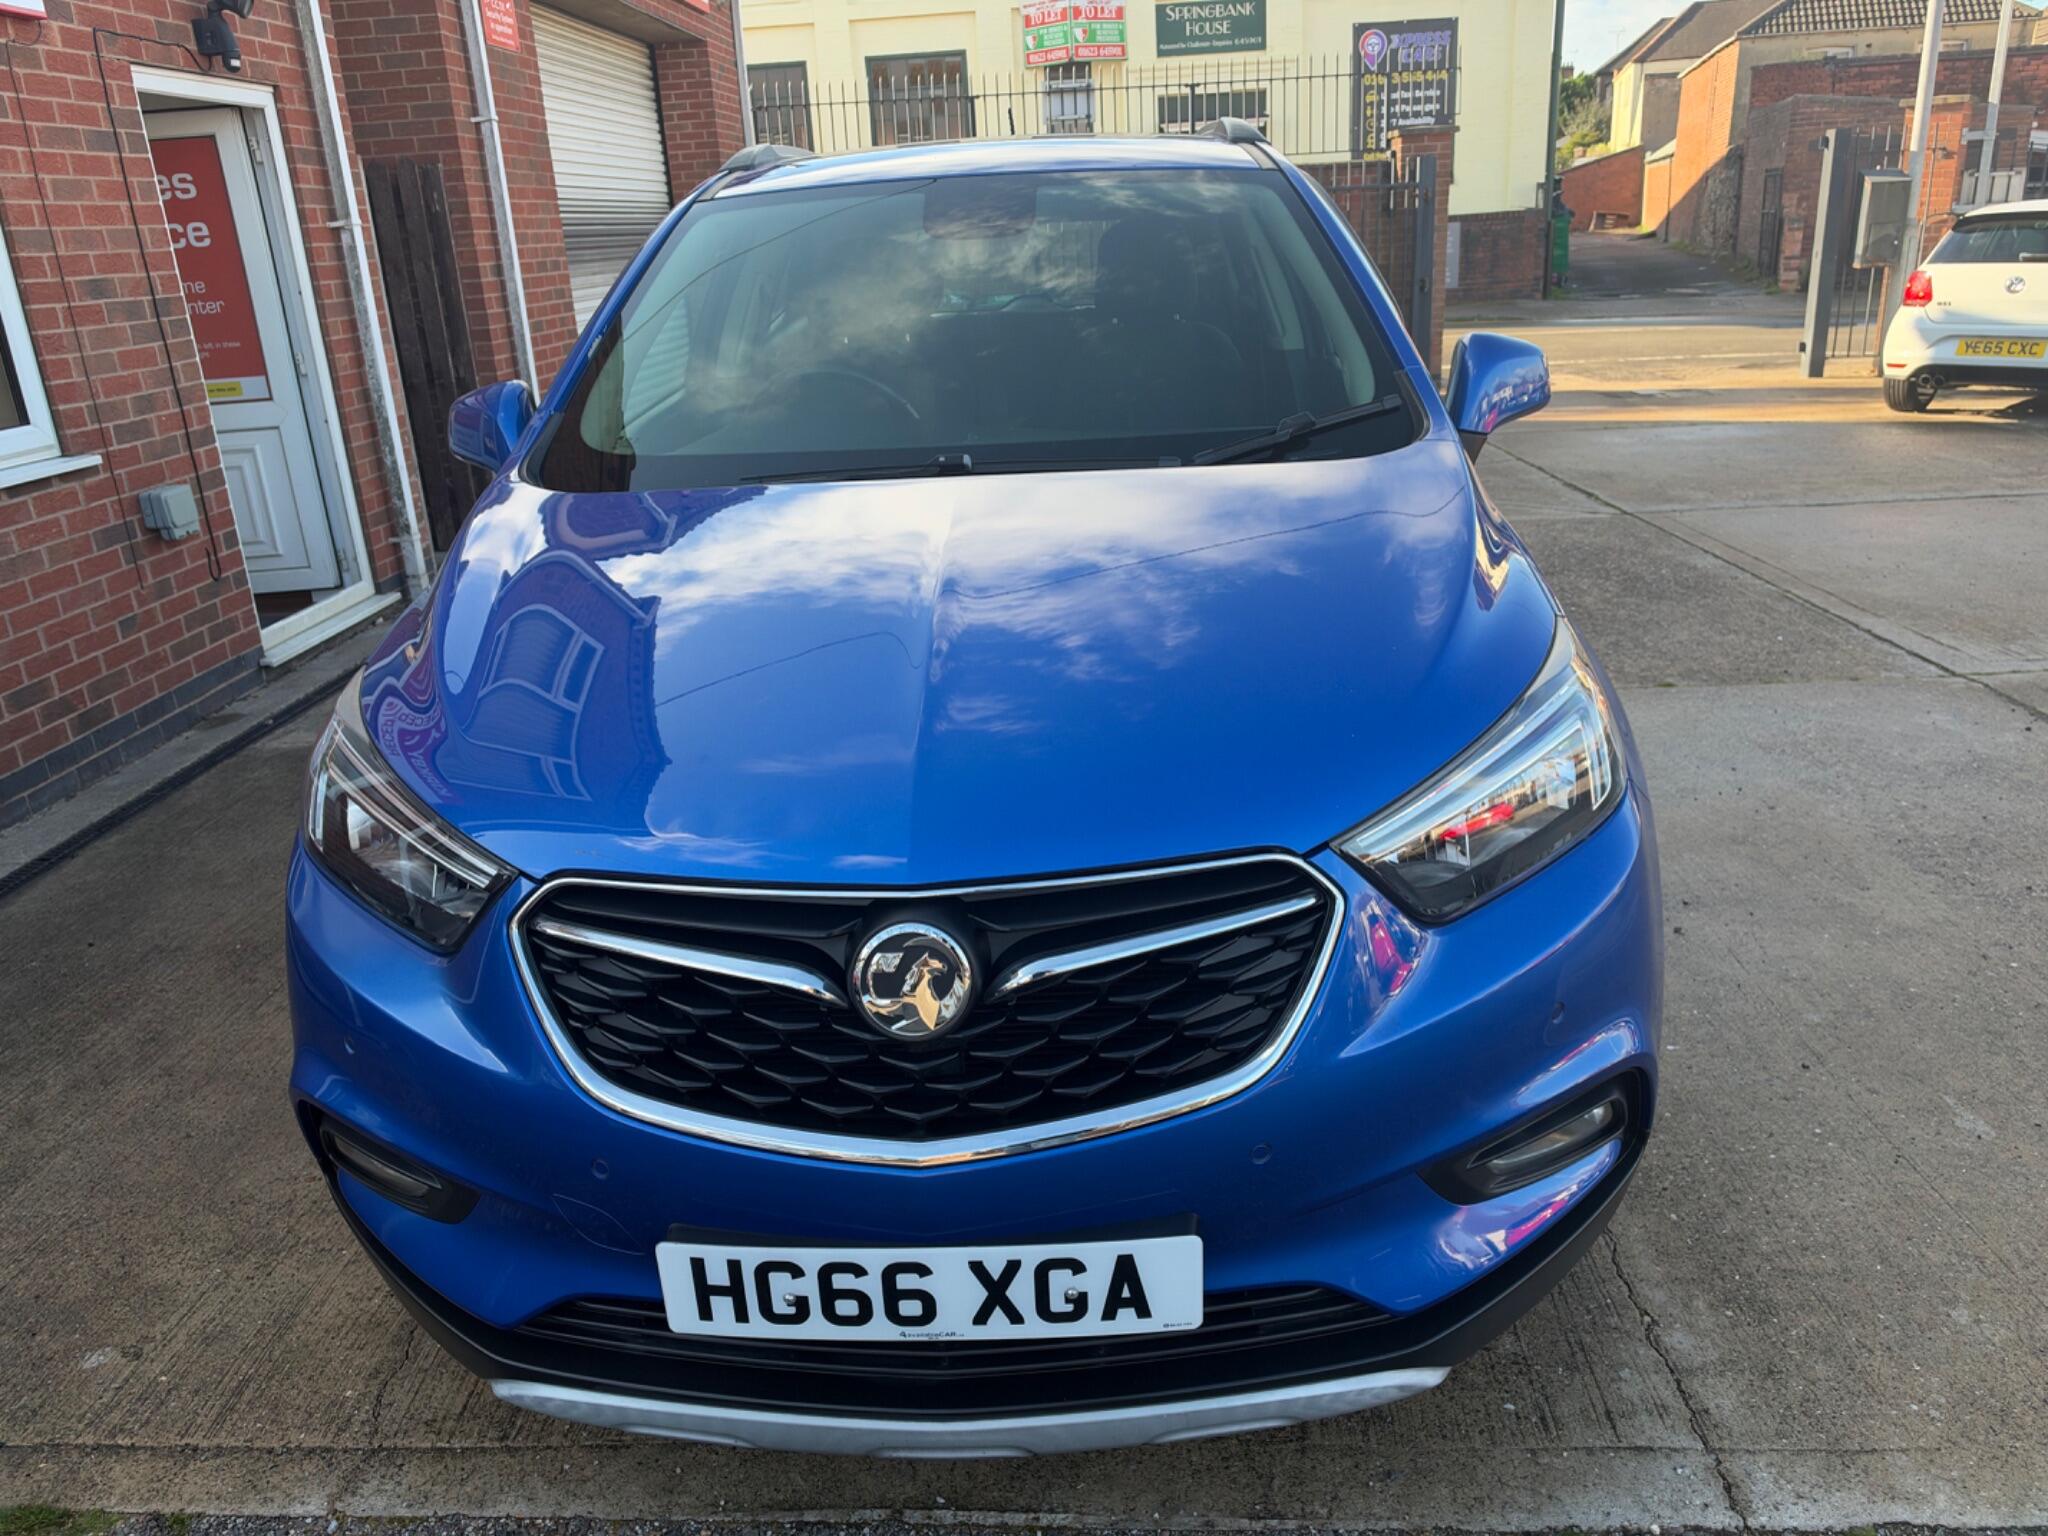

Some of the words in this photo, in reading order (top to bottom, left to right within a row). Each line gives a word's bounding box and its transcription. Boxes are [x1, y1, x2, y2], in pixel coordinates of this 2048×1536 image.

[1044, 7, 1062, 22] LET
[1081, 6, 1095, 18] TO
[1097, 5, 1117, 18] LET
[1166, 2, 1256, 21] SPRINGBANK
[1185, 20, 1232, 36] HOUSE
[1964, 340, 2004, 354] YE65
[2007, 341, 2041, 356] CXC
[689, 1256, 938, 1327] HG66
[967, 1254, 1153, 1326] XGA
